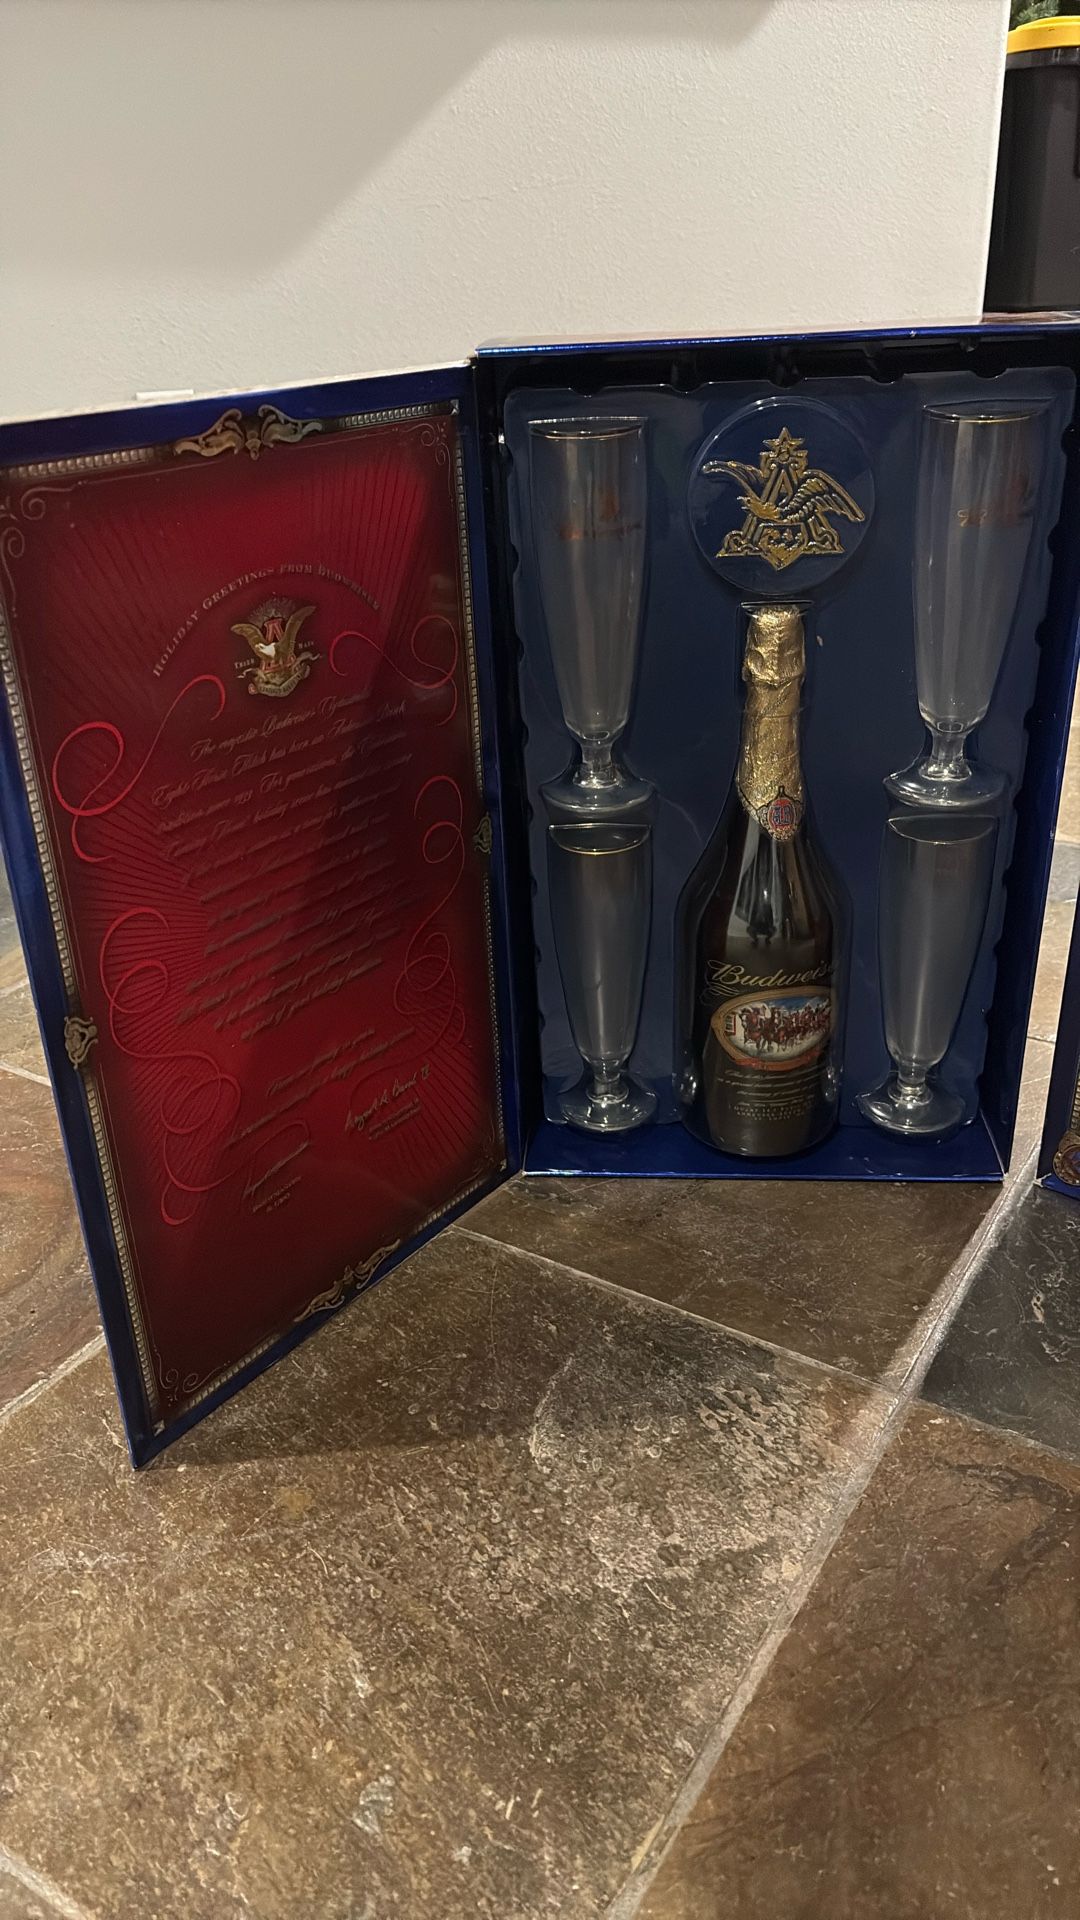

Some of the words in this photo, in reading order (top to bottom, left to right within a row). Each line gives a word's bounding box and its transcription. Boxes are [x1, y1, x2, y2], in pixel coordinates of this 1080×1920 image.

[151, 608, 200, 677] HOLIDAY
[203, 567, 275, 610] GREETINGS
[706, 958, 836, 988] Budweis
